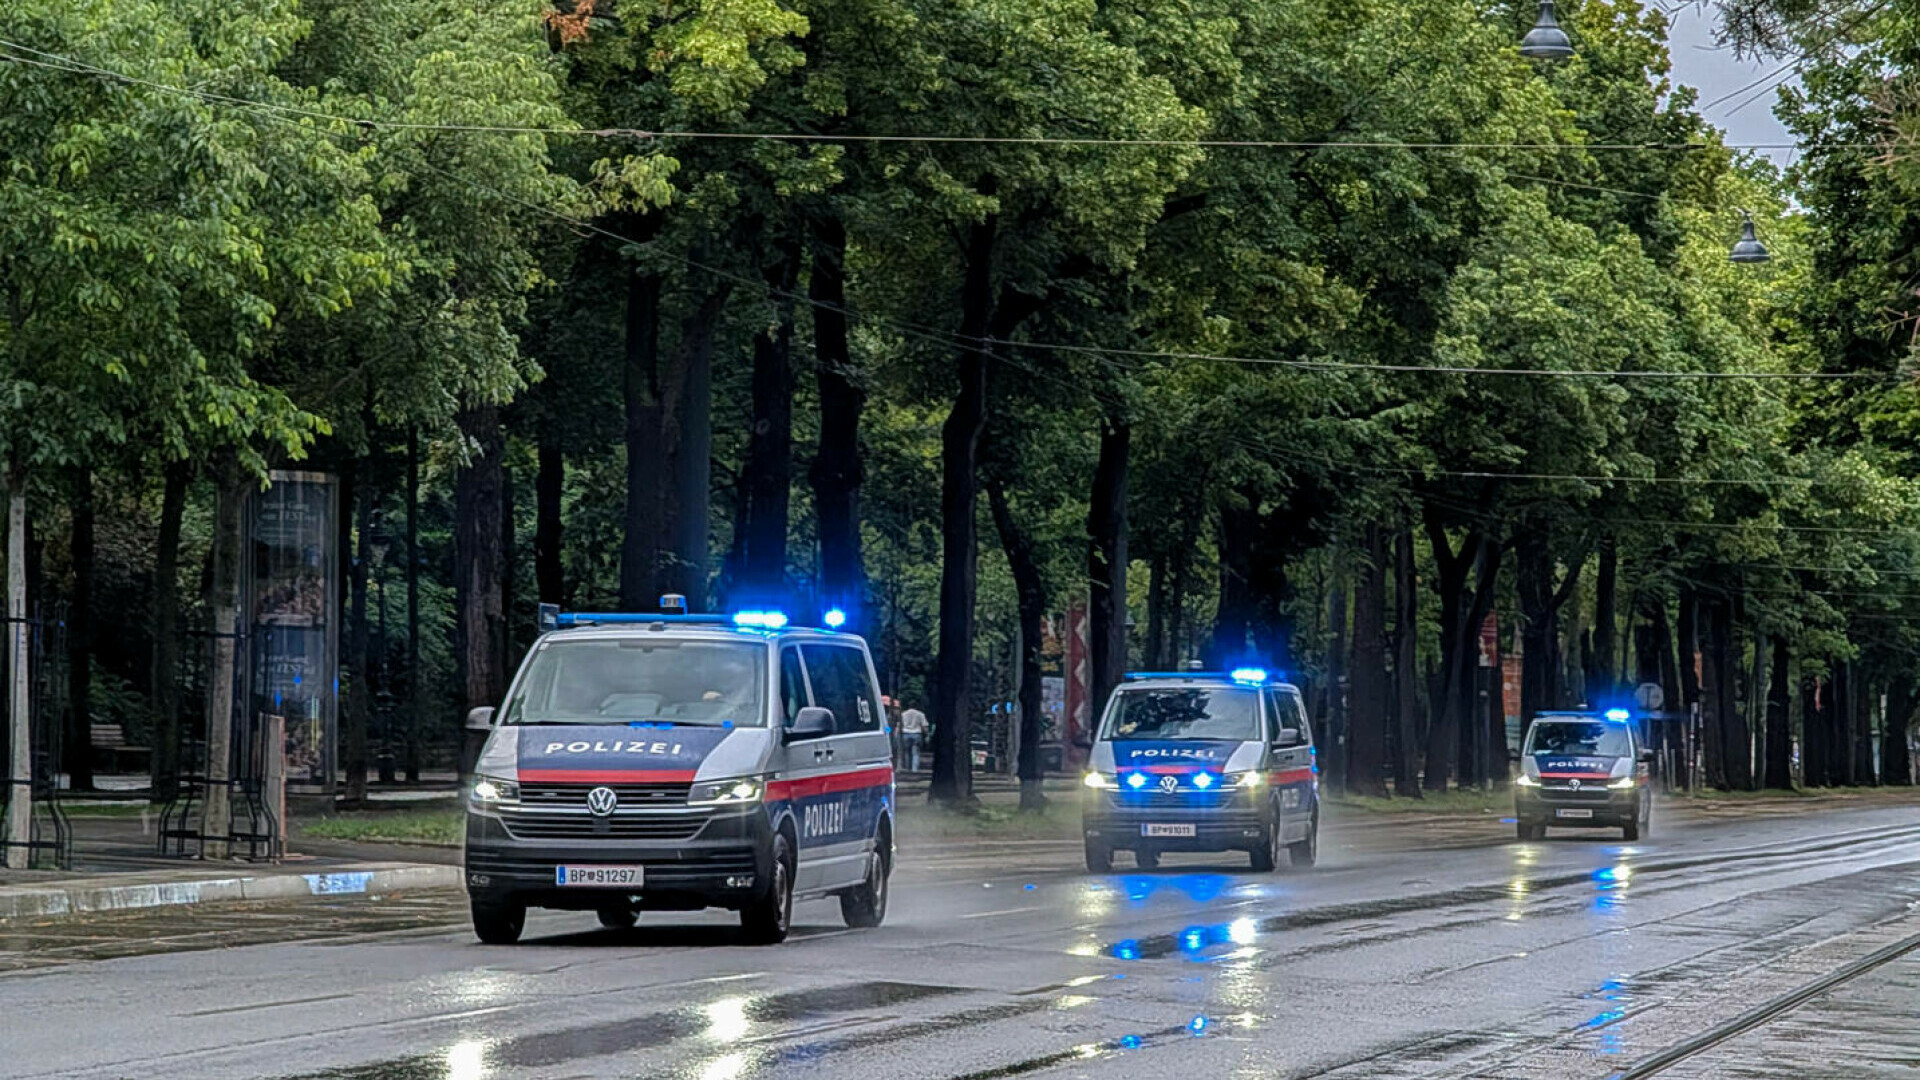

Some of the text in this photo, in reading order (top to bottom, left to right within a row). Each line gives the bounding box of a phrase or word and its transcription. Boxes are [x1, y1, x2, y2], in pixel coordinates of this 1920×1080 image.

[545, 741, 682, 755] POLIZEI
[1130, 749, 1215, 758] POLIZEI
[588, 787, 617, 816] VW
[804, 802, 843, 837] POLIZEI
[570, 869, 636, 883] BP 91297
